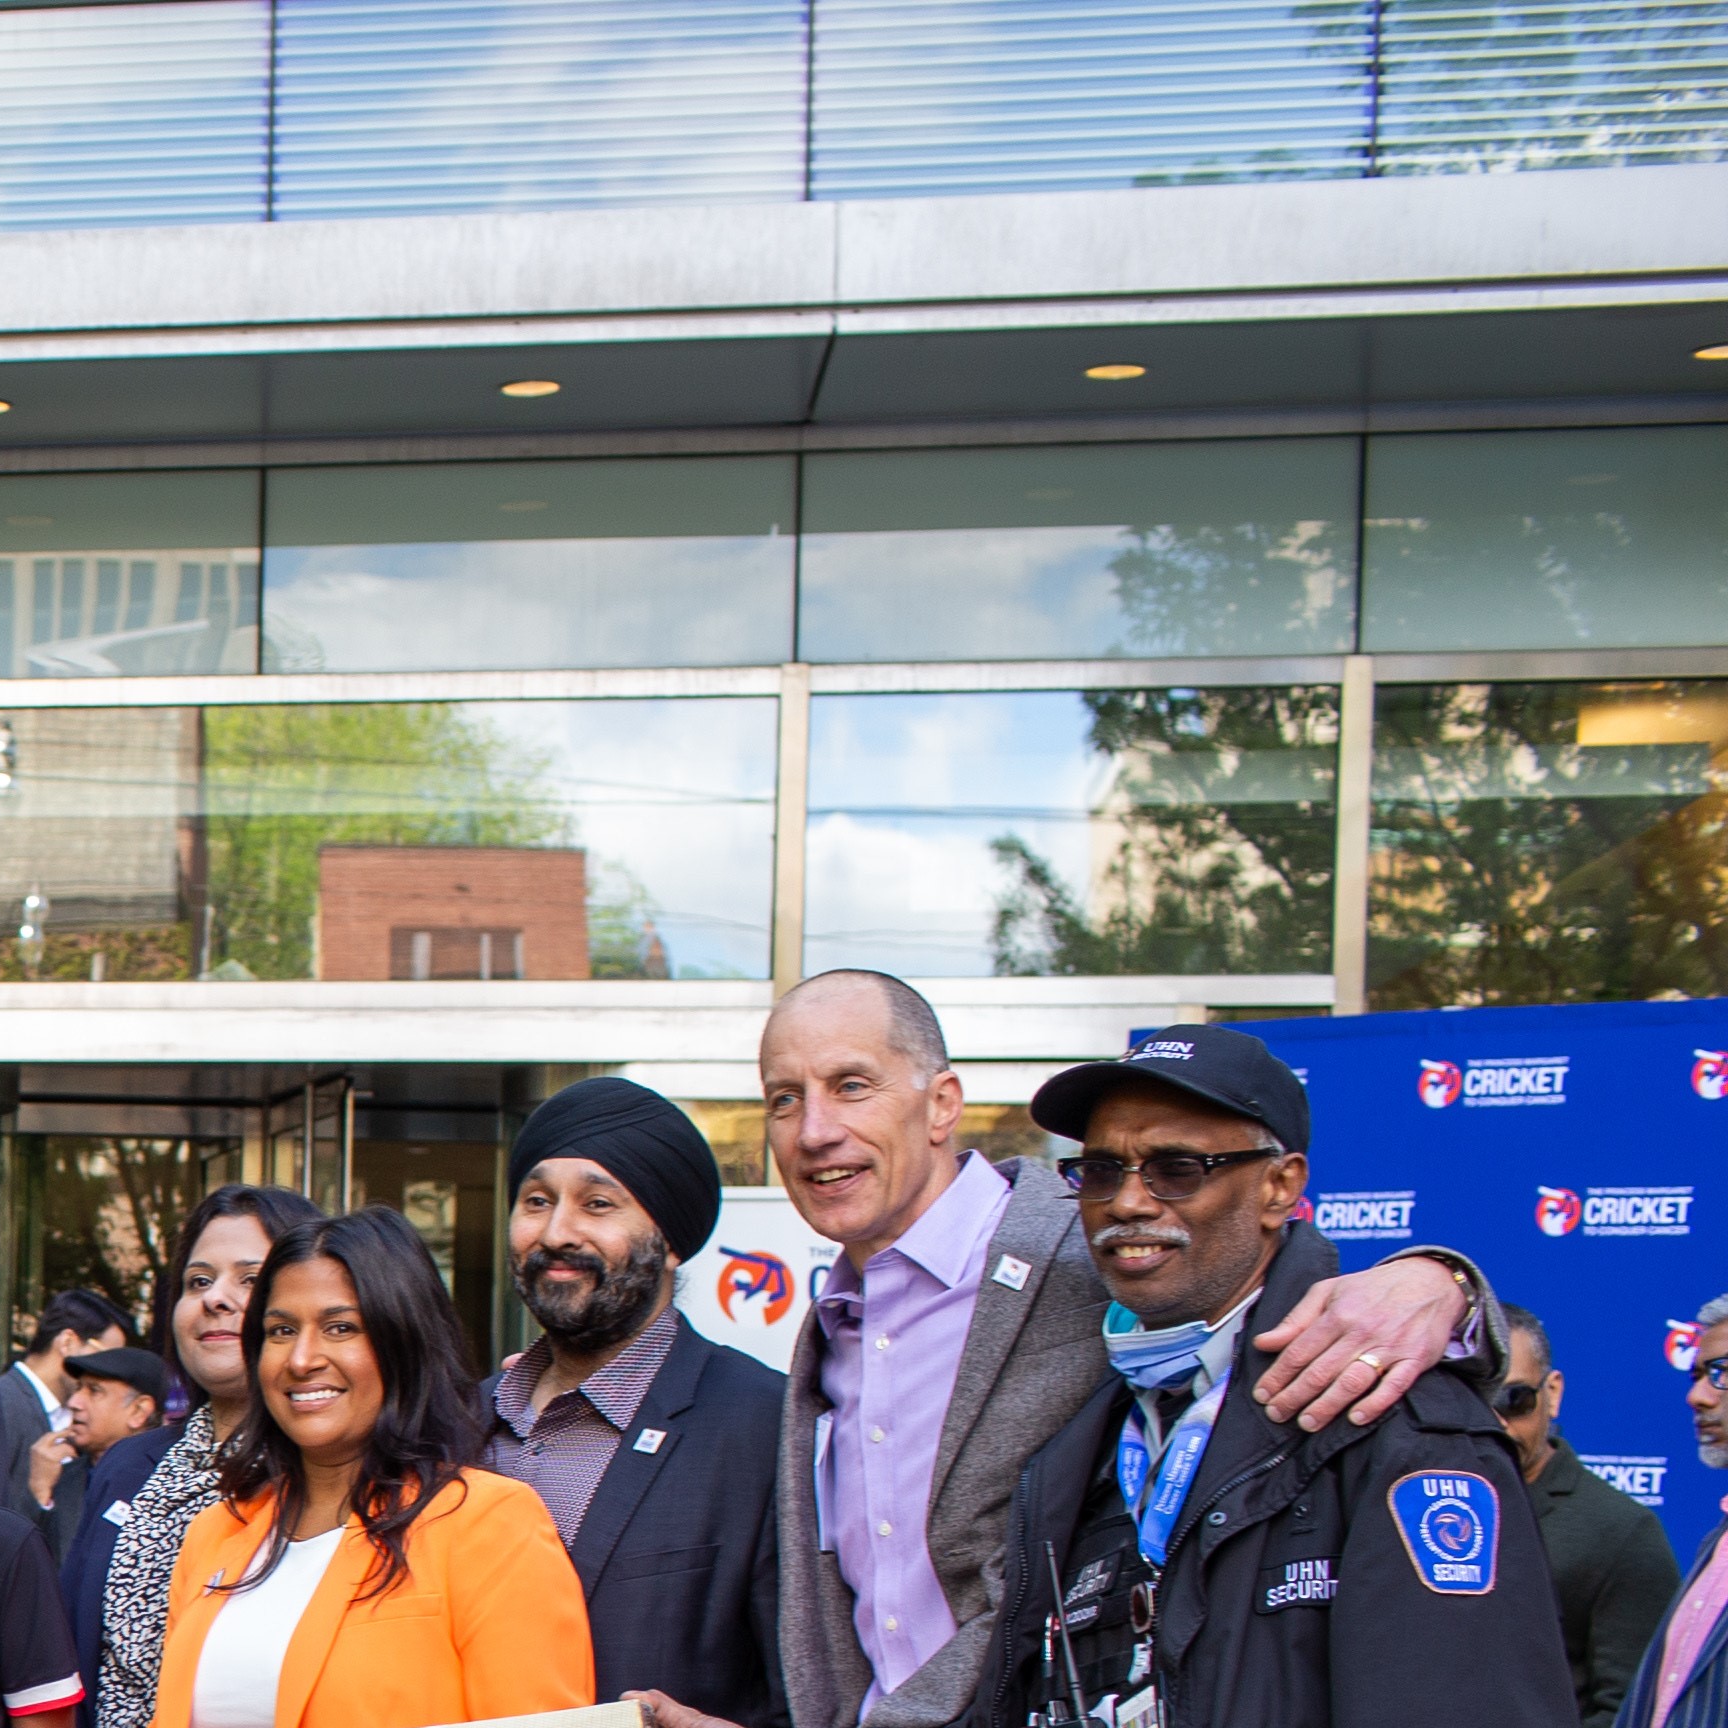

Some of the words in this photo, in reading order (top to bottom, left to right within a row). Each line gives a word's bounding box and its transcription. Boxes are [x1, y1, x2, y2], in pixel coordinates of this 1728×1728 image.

[1143, 1041, 1195, 1053] UHN
[1463, 1066, 1570, 1096] CRICKET
[1315, 1200, 1415, 1230] CRICKET
[1583, 1197, 1694, 1225] CRICKET
[1423, 1479, 1470, 1498] UHN
[1285, 1560, 1330, 1582] UHN
[1433, 1563, 1482, 1583] SECURITY
[1266, 1580, 1339, 1606] SECURIT
